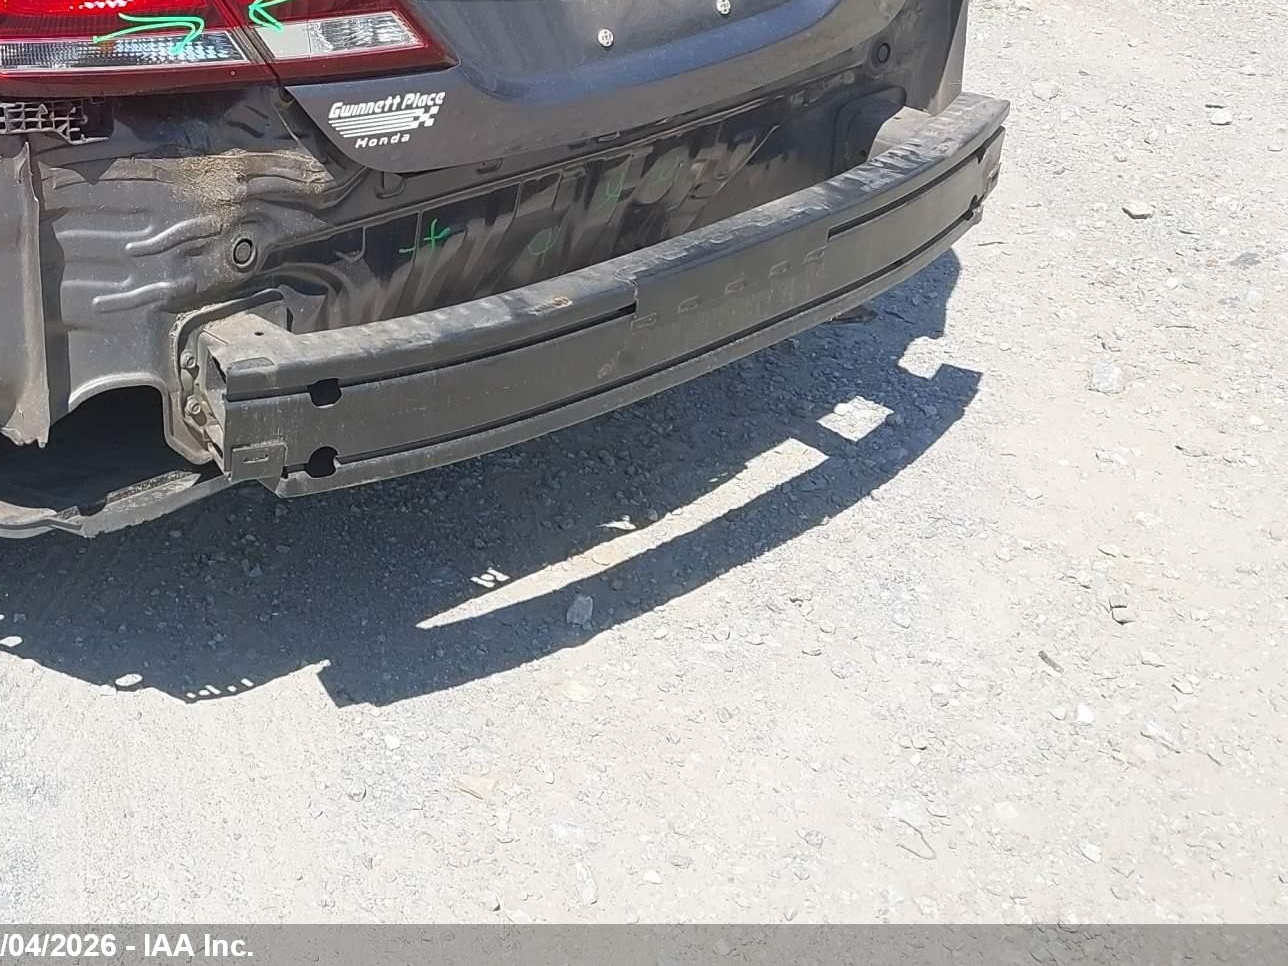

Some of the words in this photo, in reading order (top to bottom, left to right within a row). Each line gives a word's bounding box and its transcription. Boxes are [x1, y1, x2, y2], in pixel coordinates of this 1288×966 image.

[328, 94, 401, 119] Gwinnett
[400, 91, 446, 110] Place
[354, 132, 411, 149] Honda
